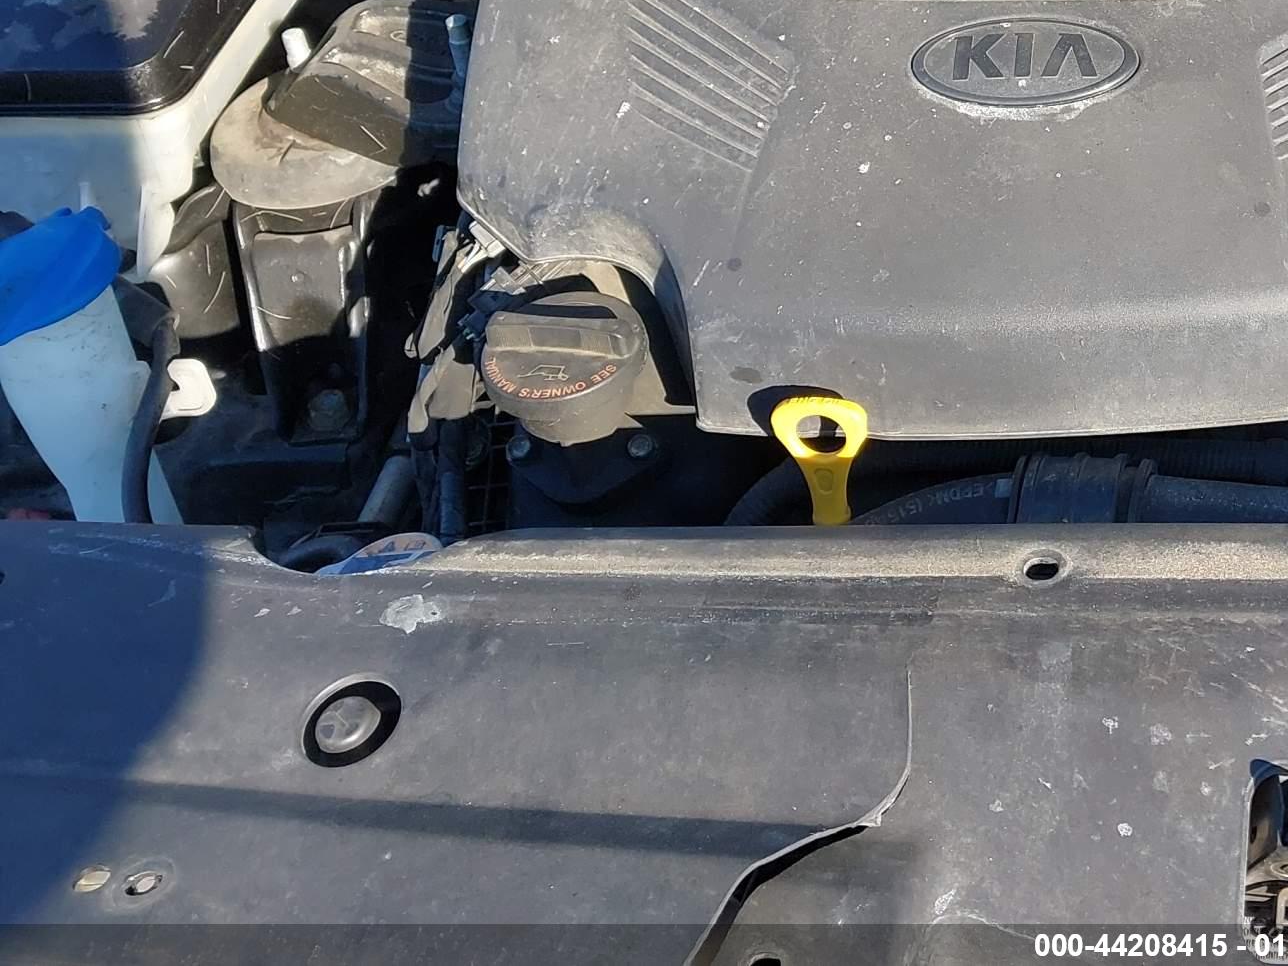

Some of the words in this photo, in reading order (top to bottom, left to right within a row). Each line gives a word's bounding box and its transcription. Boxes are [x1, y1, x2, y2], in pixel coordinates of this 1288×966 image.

[953, 33, 1098, 81] KIA
[483, 356, 517, 394] MANUAL
[592, 364, 617, 384] SEE
[519, 382, 587, 399] OWNER'S
